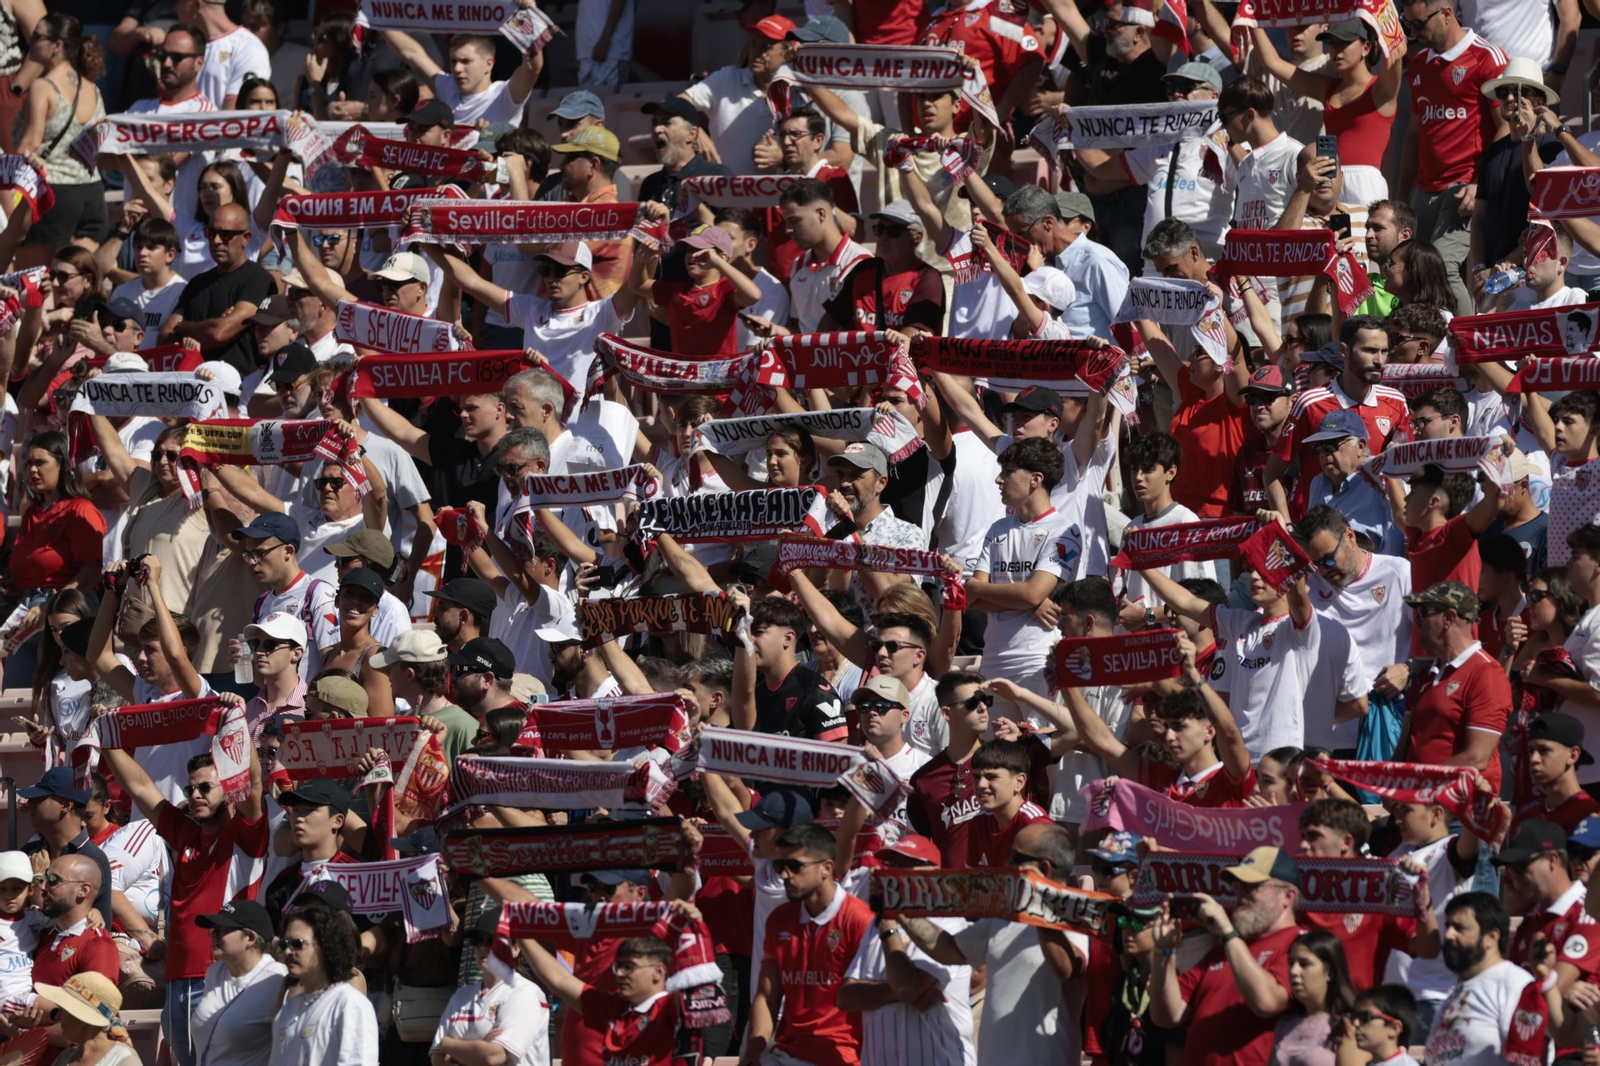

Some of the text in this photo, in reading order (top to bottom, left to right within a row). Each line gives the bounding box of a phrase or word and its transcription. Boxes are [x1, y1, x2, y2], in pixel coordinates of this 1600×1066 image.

[371, 0, 505, 23] NUNCA ME RINDO
[873, 59, 903, 78] ME
[1421, 96, 1467, 124] Midea
[116, 115, 282, 143] SUPERCOPA
[1080, 117, 1135, 137] NUNCA
[1139, 115, 1159, 135] TE
[381, 145, 449, 170] SEVILLA FC
[1151, 169, 1196, 193] Mdea
[447, 207, 619, 231] SevillaFútbolClub
[1240, 199, 1267, 219] SUPER
[1218, 241, 1331, 264] NUNCA TE RINDAS
[1131, 287, 1160, 308] NUNCA
[1162, 291, 1173, 309] TE
[368, 309, 423, 353] SEVILLA
[1472, 320, 1554, 351] NAVAS
[372, 361, 443, 388] SEVILLA
[447, 361, 472, 385] FC
[79, 382, 214, 405] NUNCA TE RINDAS
[205, 430, 225, 438] UEFA
[228, 431, 243, 439] CUP
[711, 422, 775, 443] NUNCA
[800, 409, 862, 431] RINDAS
[1393, 437, 1490, 466] NUNCA ME RINDO
[583, 474, 609, 494] ME
[1128, 529, 1180, 552] NUNCA
[1185, 528, 1203, 545] TE
[616, 595, 679, 630] PORQUE
[681, 595, 701, 624] TE
[1124, 636, 1151, 648] EUROPA
[475, 655, 493, 669] SEVILLA
[1102, 646, 1181, 674] SEVILLA FC
[711, 738, 851, 774] NUNCA ME RINDO
[1144, 799, 1284, 847] SevillaGirls
[488, 834, 591, 870] Sevilla
[1301, 869, 1385, 903] ORTE
[509, 902, 560, 925] AVAS
